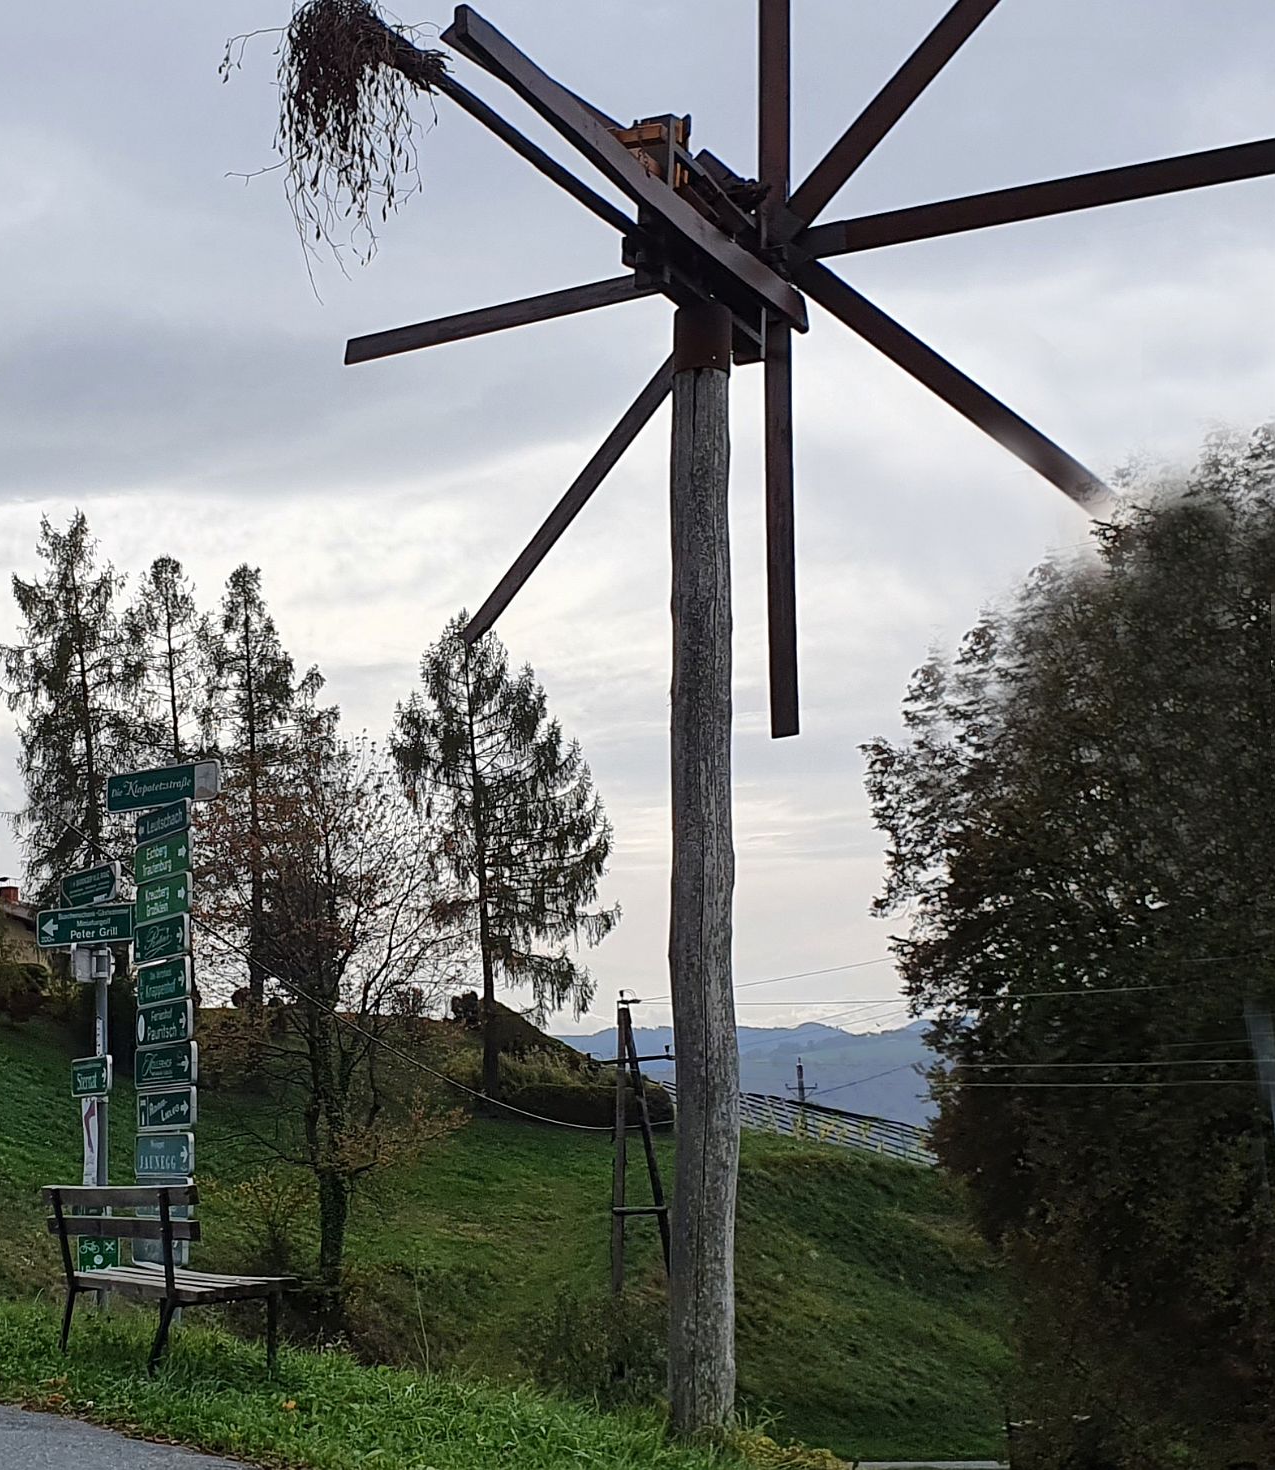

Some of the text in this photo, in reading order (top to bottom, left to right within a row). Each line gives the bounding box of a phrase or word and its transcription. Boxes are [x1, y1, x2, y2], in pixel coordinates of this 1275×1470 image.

[111, 788, 123, 798] Die
[146, 808, 183, 835] Leutschach
[146, 845, 168, 861] Eichberg
[70, 926, 118, 940] Peter Grill
[147, 1022, 178, 1041] Pauritsch
[76, 1072, 98, 1091] Sternat
[140, 1155, 176, 1170] JAUNEGG
